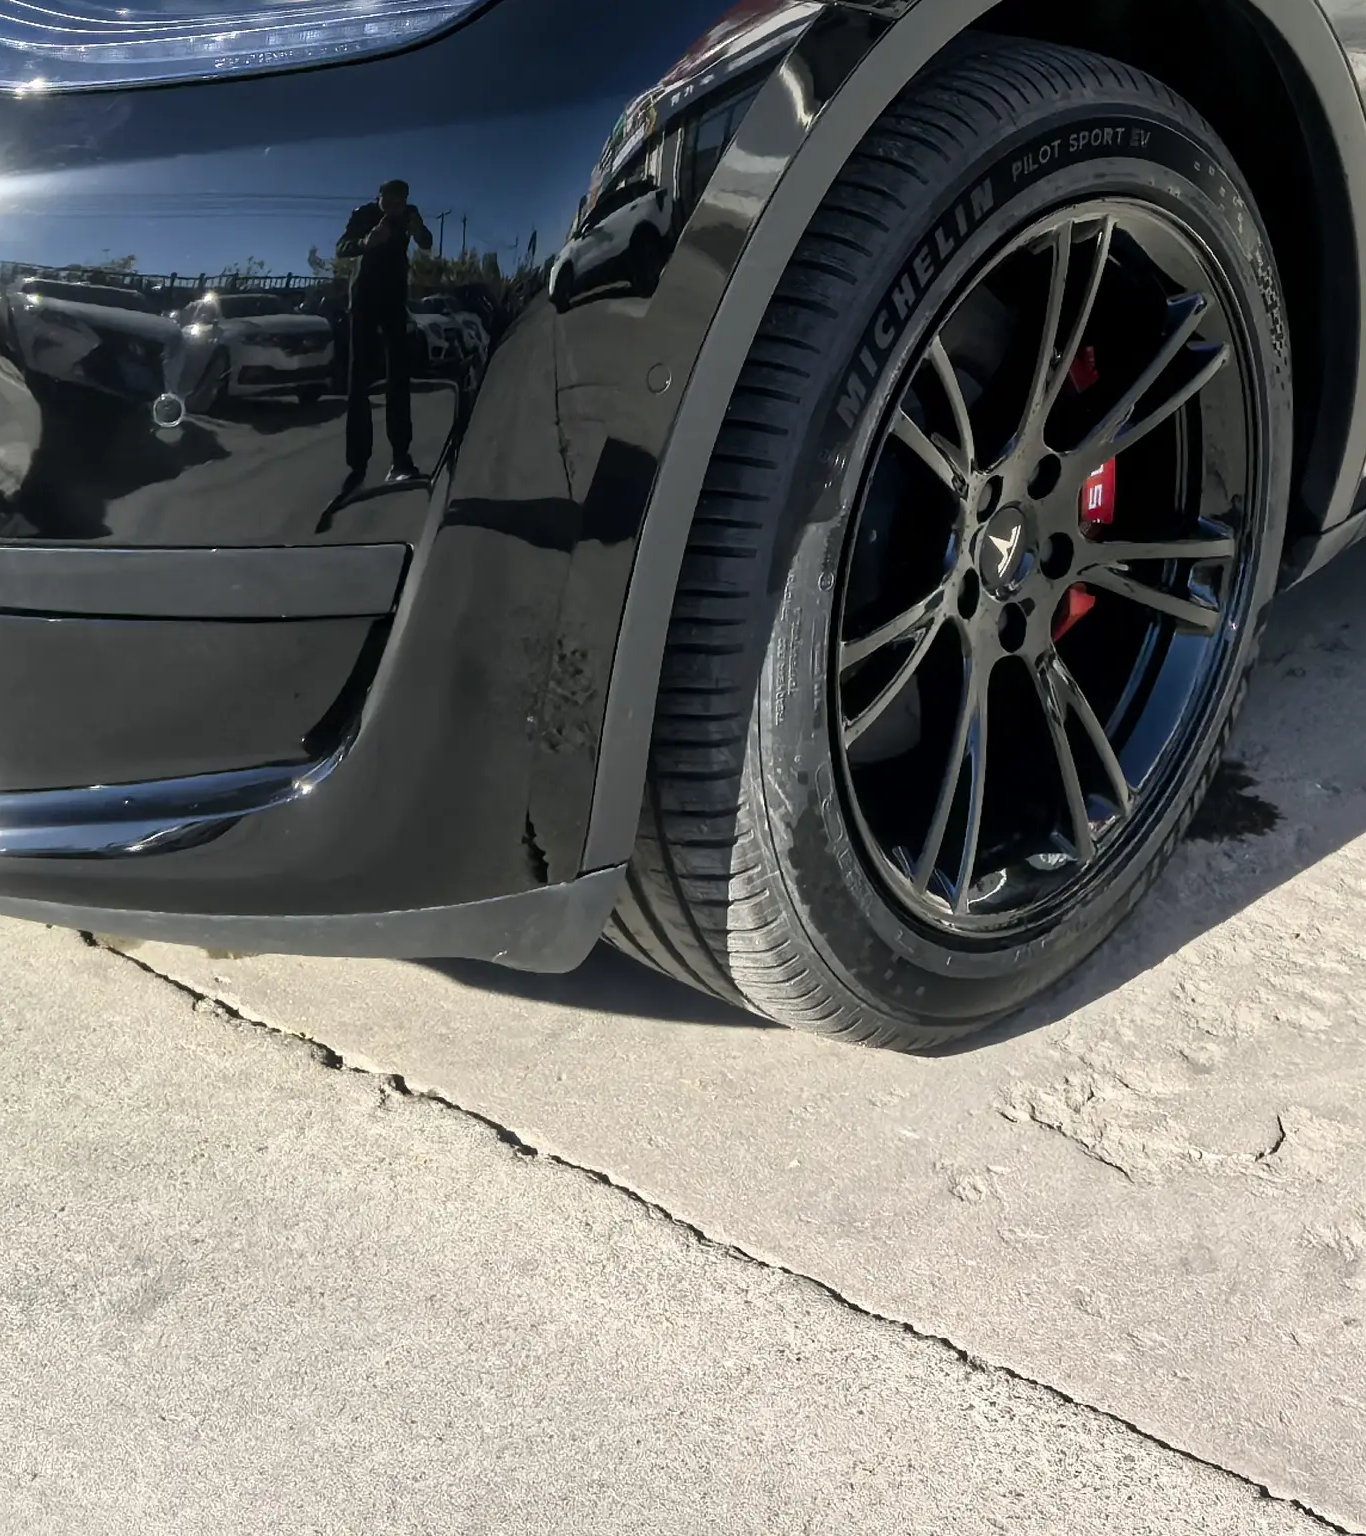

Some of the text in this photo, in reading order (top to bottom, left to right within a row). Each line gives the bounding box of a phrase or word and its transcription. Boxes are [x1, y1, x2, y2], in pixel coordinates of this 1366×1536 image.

[836, 177, 995, 430] MICHELIN
[1011, 139, 1062, 183] PILOT
[1068, 127, 1126, 153] SPORT
